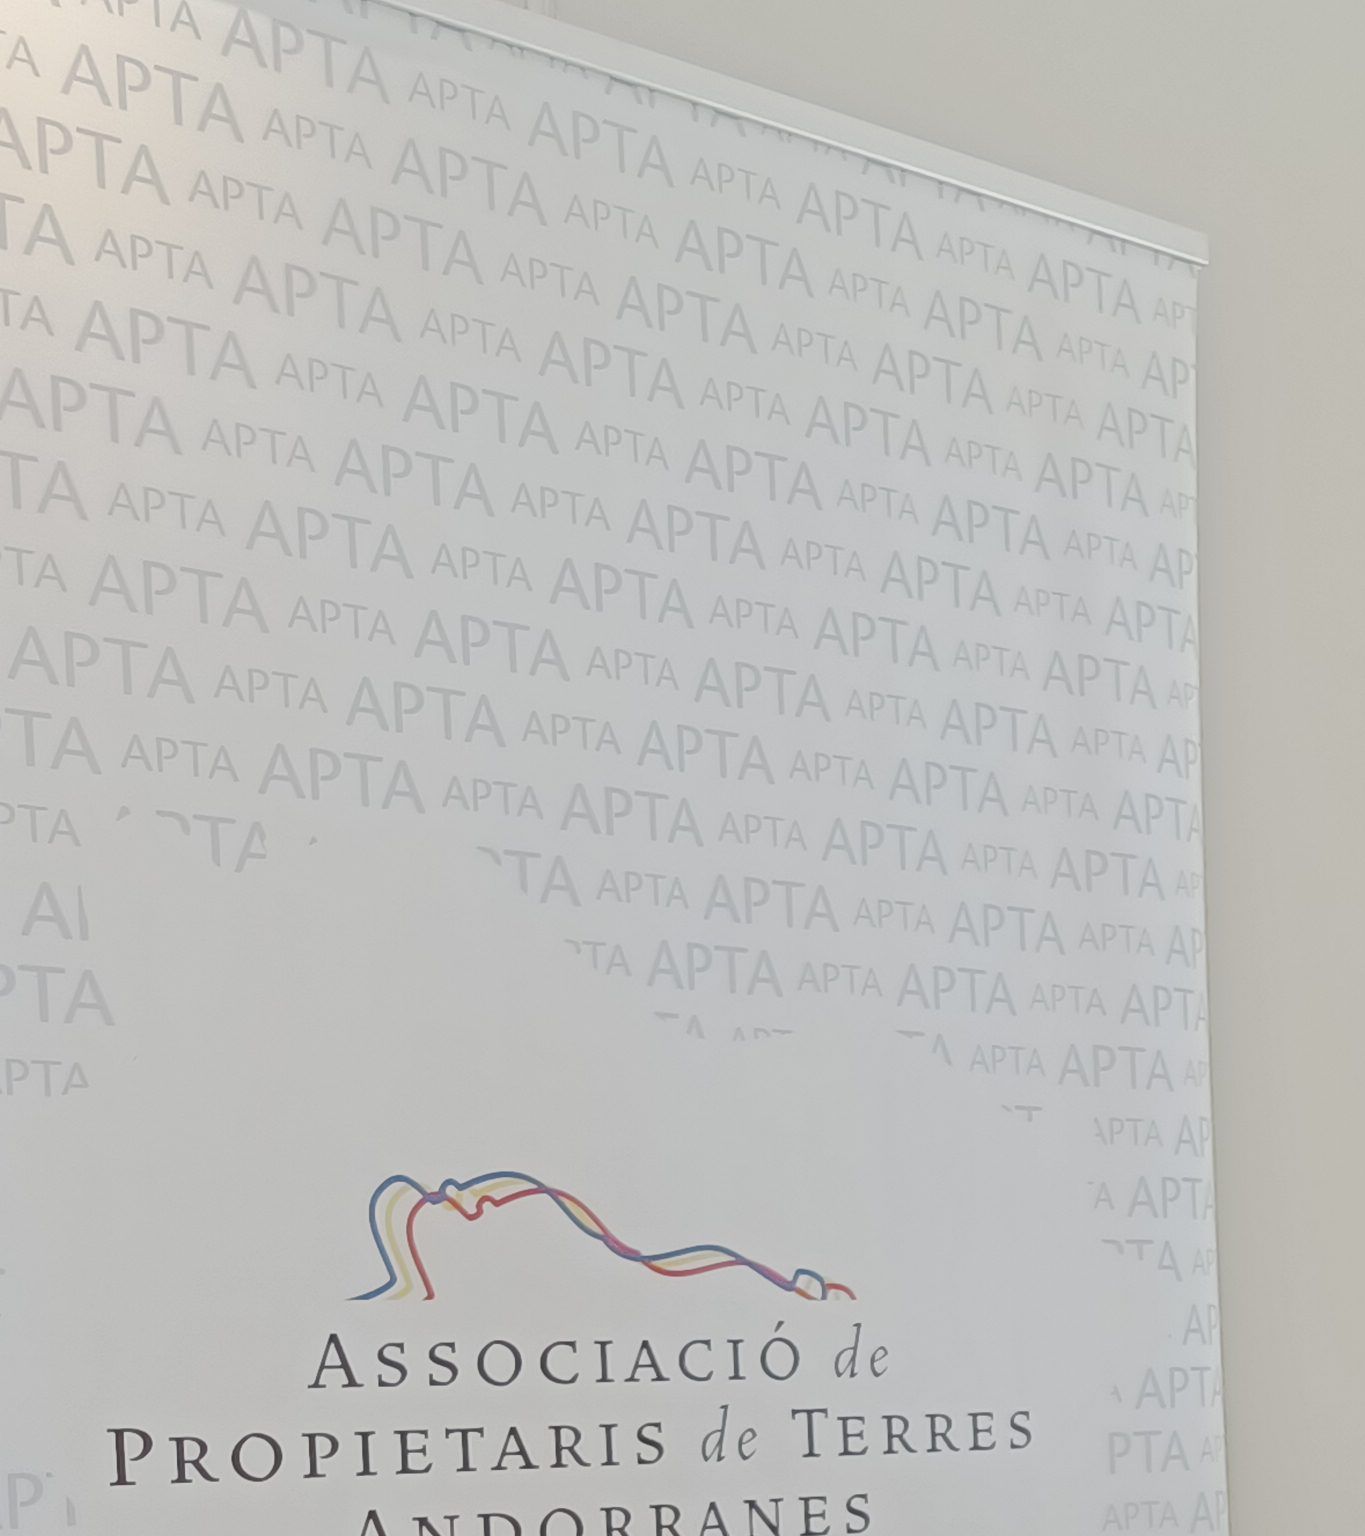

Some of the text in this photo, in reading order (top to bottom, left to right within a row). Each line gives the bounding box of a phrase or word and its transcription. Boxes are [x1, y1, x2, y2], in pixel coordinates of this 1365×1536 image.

[0, 107, 758, 355] APTA APTA APTA APTA
[61, 44, 1043, 362] APTA APTA APTA APTA APTA
[408, 72, 1141, 324] APTA APTA APTA APTA
[74, 300, 1137, 570] APTA APTA APTA APTA APTA APTA
[94, 228, 1149, 517] APTA APTA APTA APTA
[0, 367, 1002, 617] APTA APTA APTA APTA APTA APTA
[88, 554, 831, 722] APTA APTA APTA APTA APTA
[107, 482, 1157, 709] APTA APTA APTA APTA APTA APTA
[7, 625, 1009, 817] APTA APTA APTA APTA APTA APTA
[121, 734, 1165, 900] APTA APTA APTA APTA APTA APTA
[646, 939, 1017, 1016] APTA APTA
[703, 874, 840, 932] APTA
[1058, 1043, 1173, 1091] APTA
[107, 1404, 1031, 1486] PROPIETARIS de TERRES
[308, 1320, 888, 1389] ASSOCIACIÓ de
